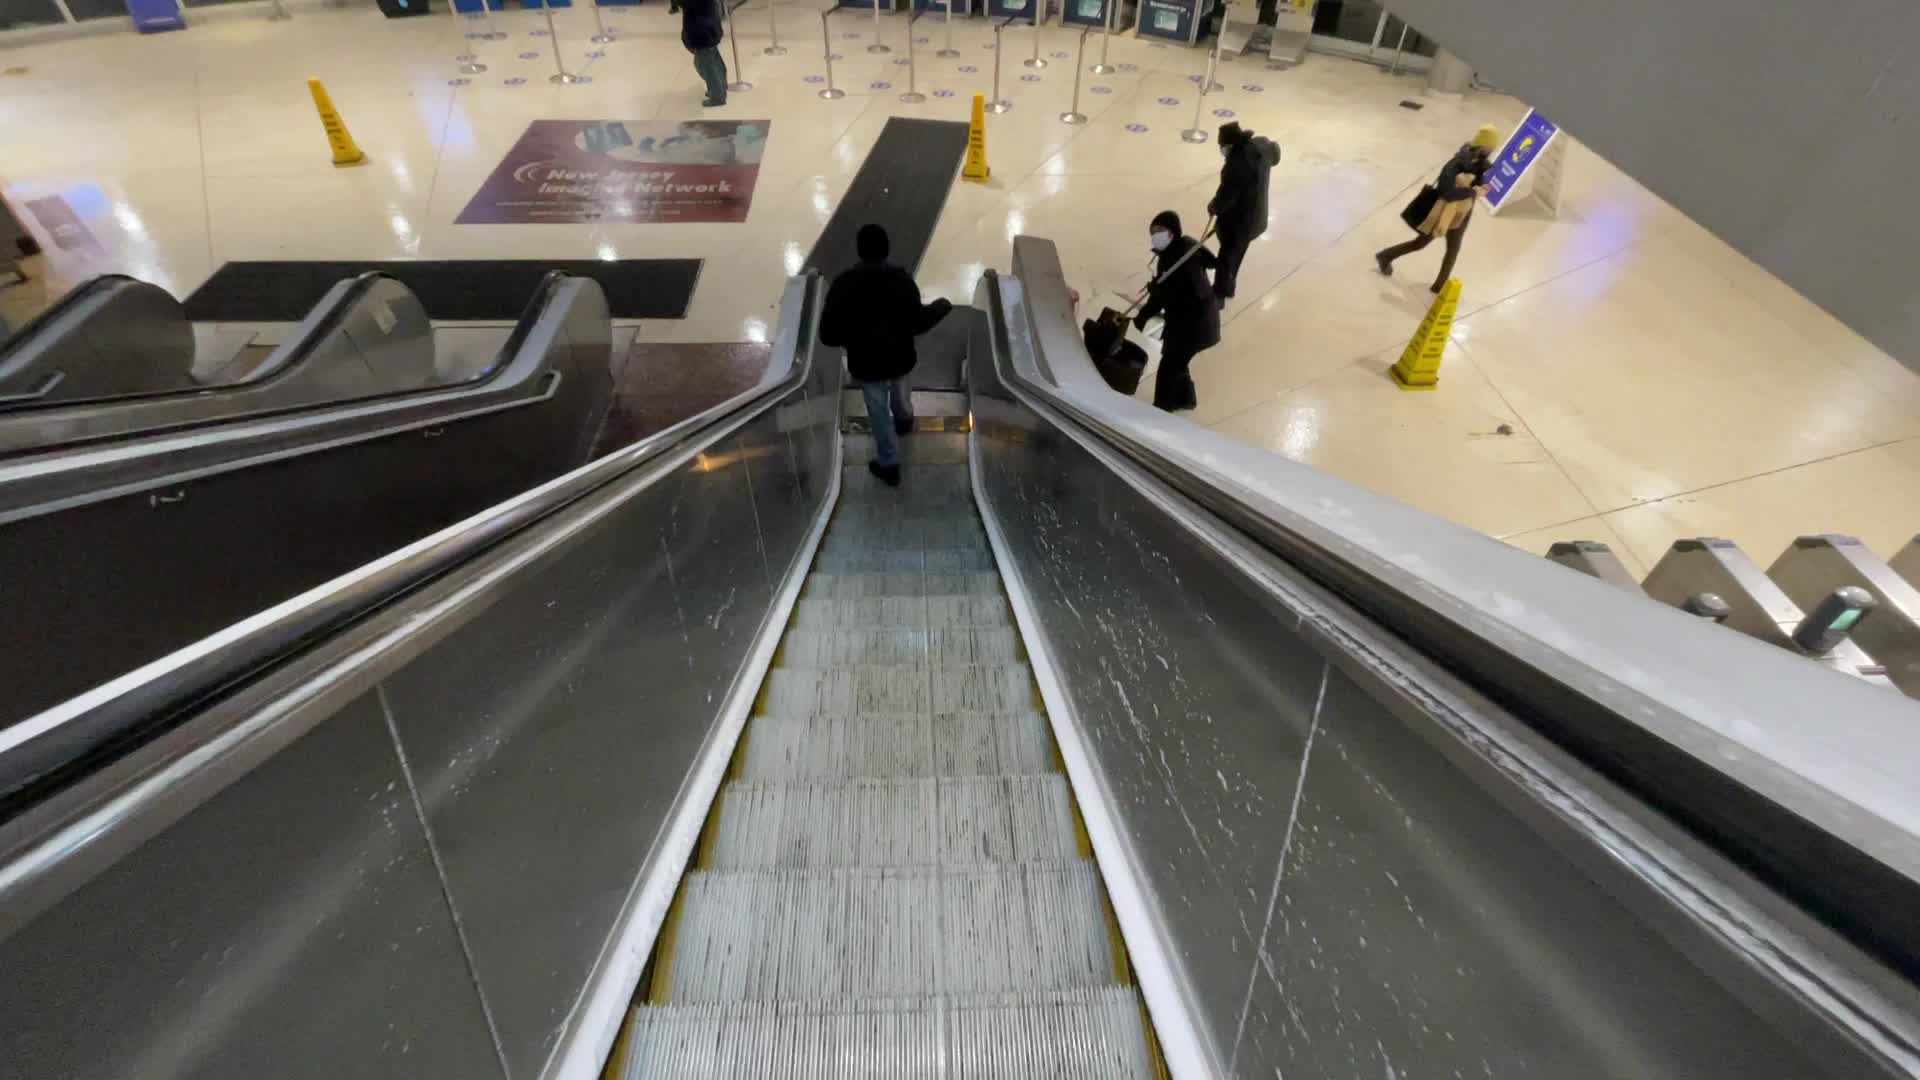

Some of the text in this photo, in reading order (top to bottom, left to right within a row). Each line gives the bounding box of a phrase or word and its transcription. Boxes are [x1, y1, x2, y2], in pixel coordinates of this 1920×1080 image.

[546, 168, 676, 182] New Jersey
[634, 180, 732, 193] Network
